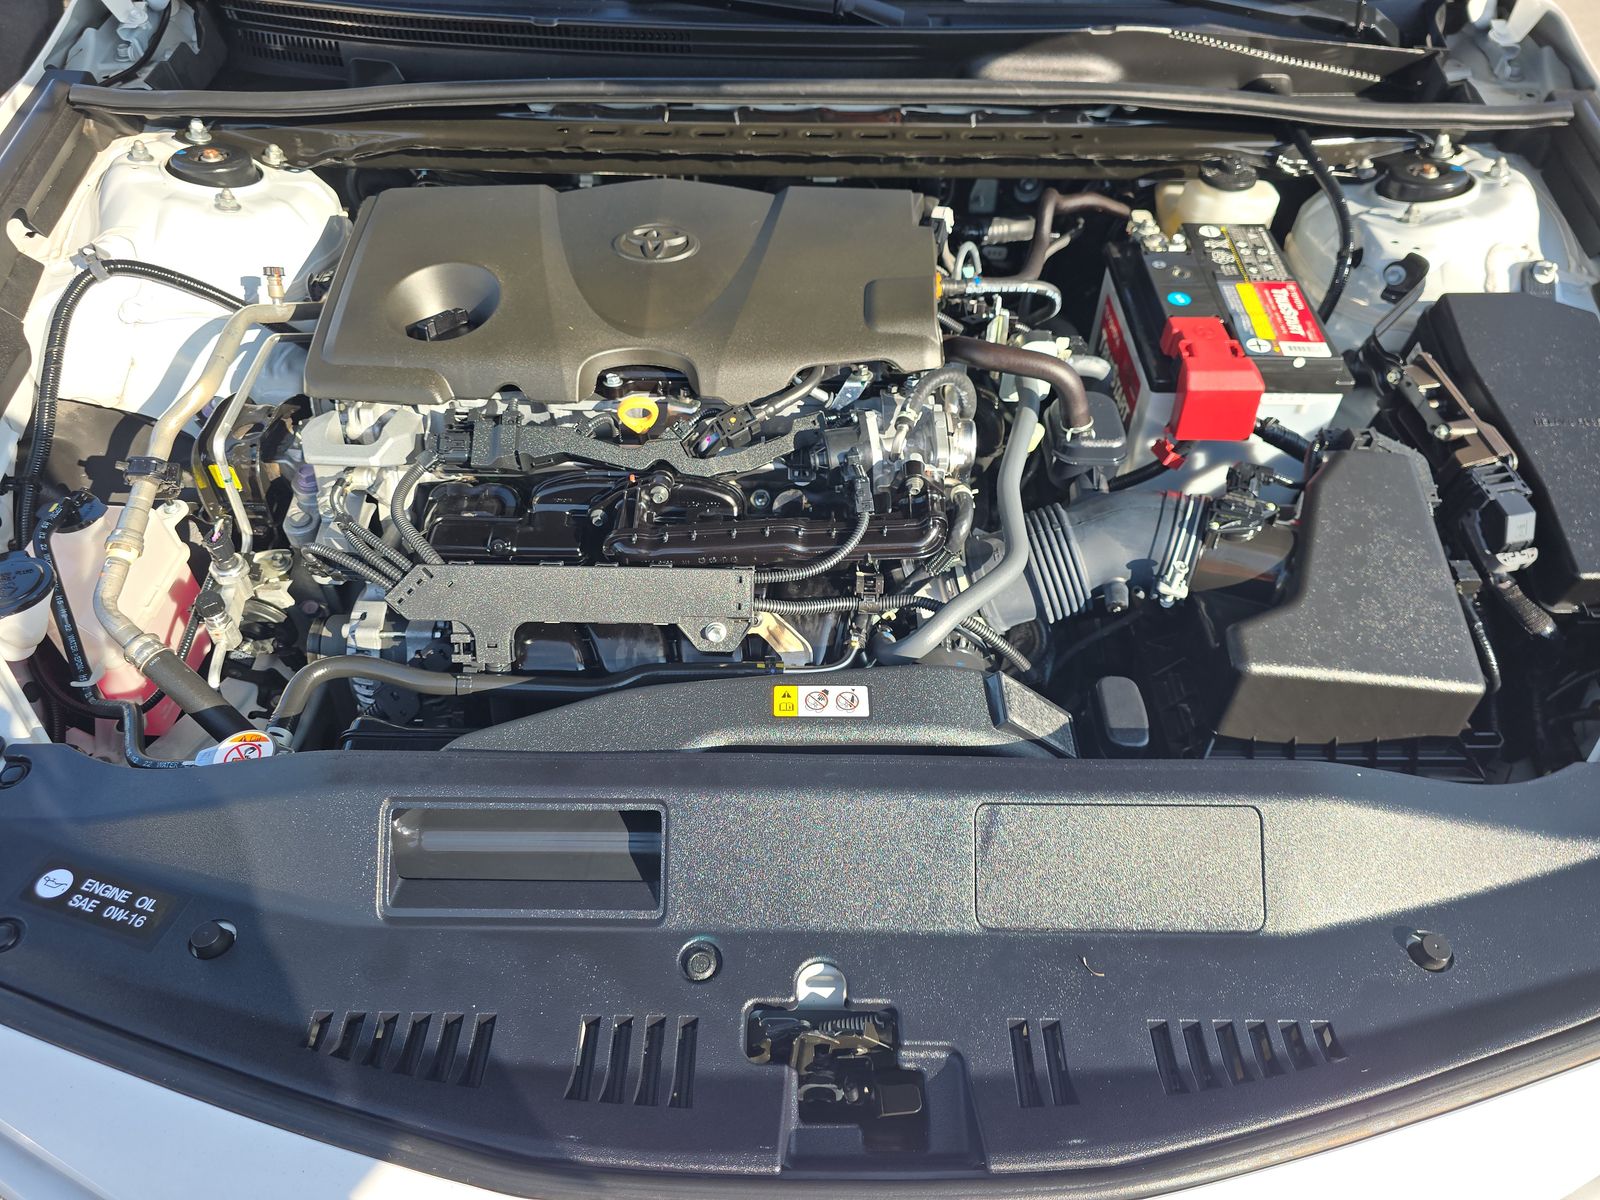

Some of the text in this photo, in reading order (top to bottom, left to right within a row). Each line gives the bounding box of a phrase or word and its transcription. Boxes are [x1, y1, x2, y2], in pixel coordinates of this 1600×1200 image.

[67, 894, 147, 928] SAE 0W-16
[81, 878, 157, 913] ENGINE OIL
